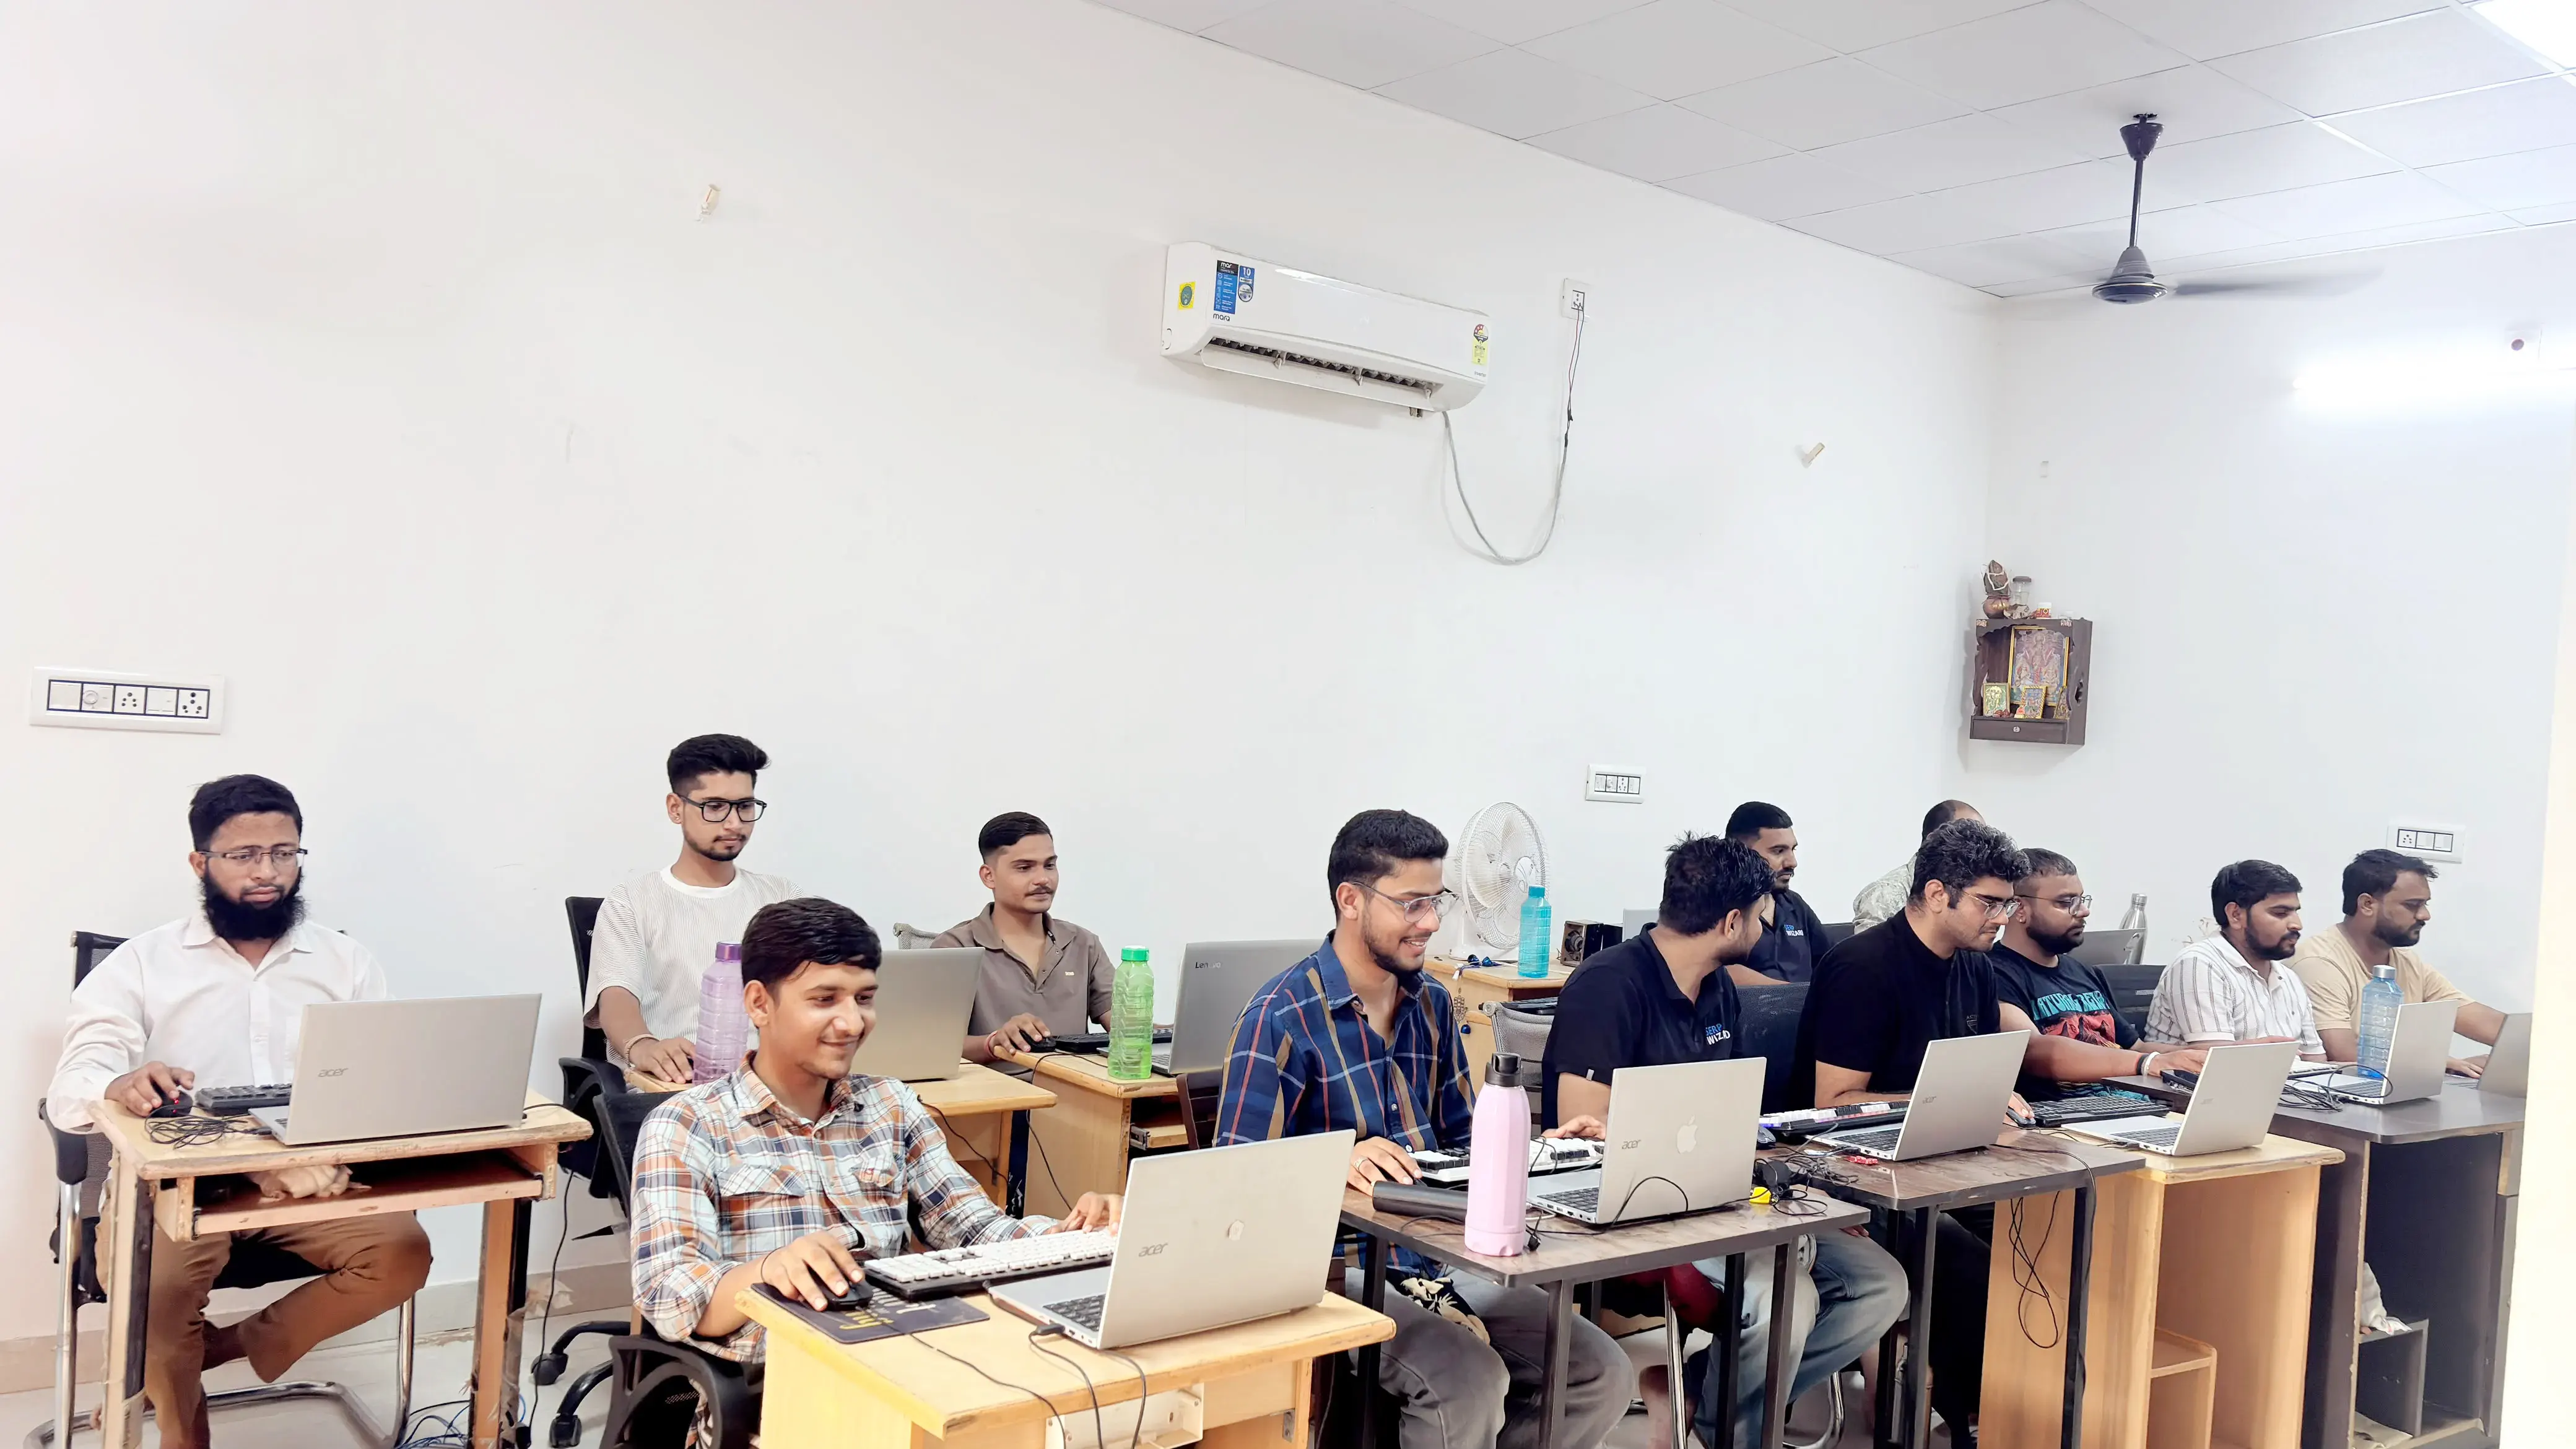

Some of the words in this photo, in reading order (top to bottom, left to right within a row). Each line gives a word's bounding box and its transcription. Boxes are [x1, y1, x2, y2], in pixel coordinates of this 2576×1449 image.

[1243, 267, 1251, 276] 10
[318, 1068, 349, 1077] acer
[1622, 1139, 1642, 1149] acer
[1138, 1242, 1168, 1257] acer
